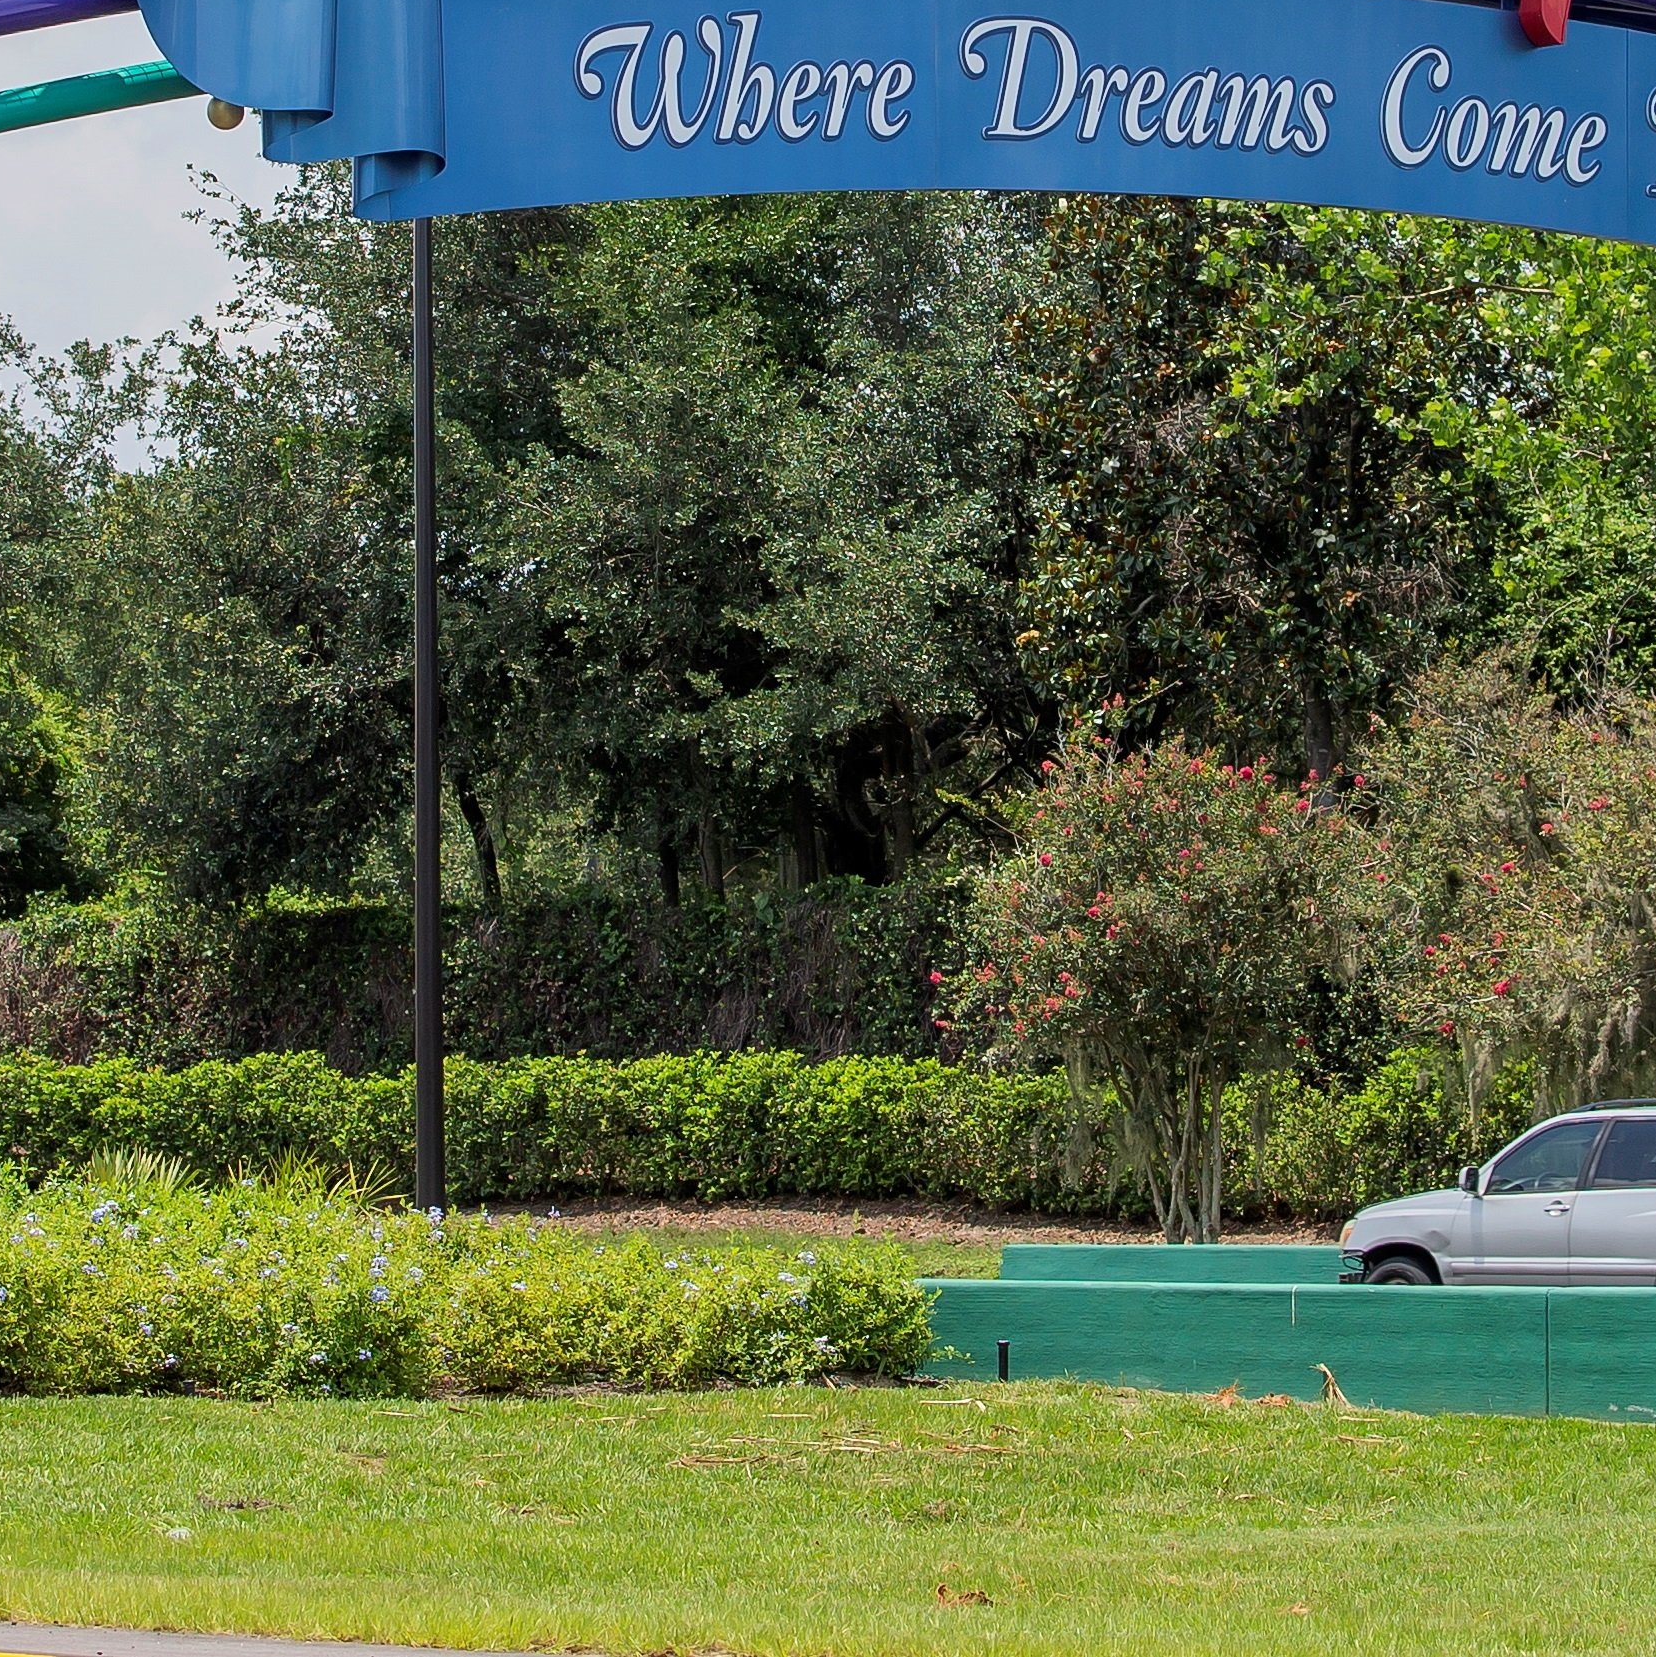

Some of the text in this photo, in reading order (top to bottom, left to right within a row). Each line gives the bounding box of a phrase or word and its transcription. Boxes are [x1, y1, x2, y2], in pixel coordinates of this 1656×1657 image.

[576, 11, 914, 149] Where
[961, 16, 1334, 152] Dreams
[1381, 46, 1607, 186] Come
